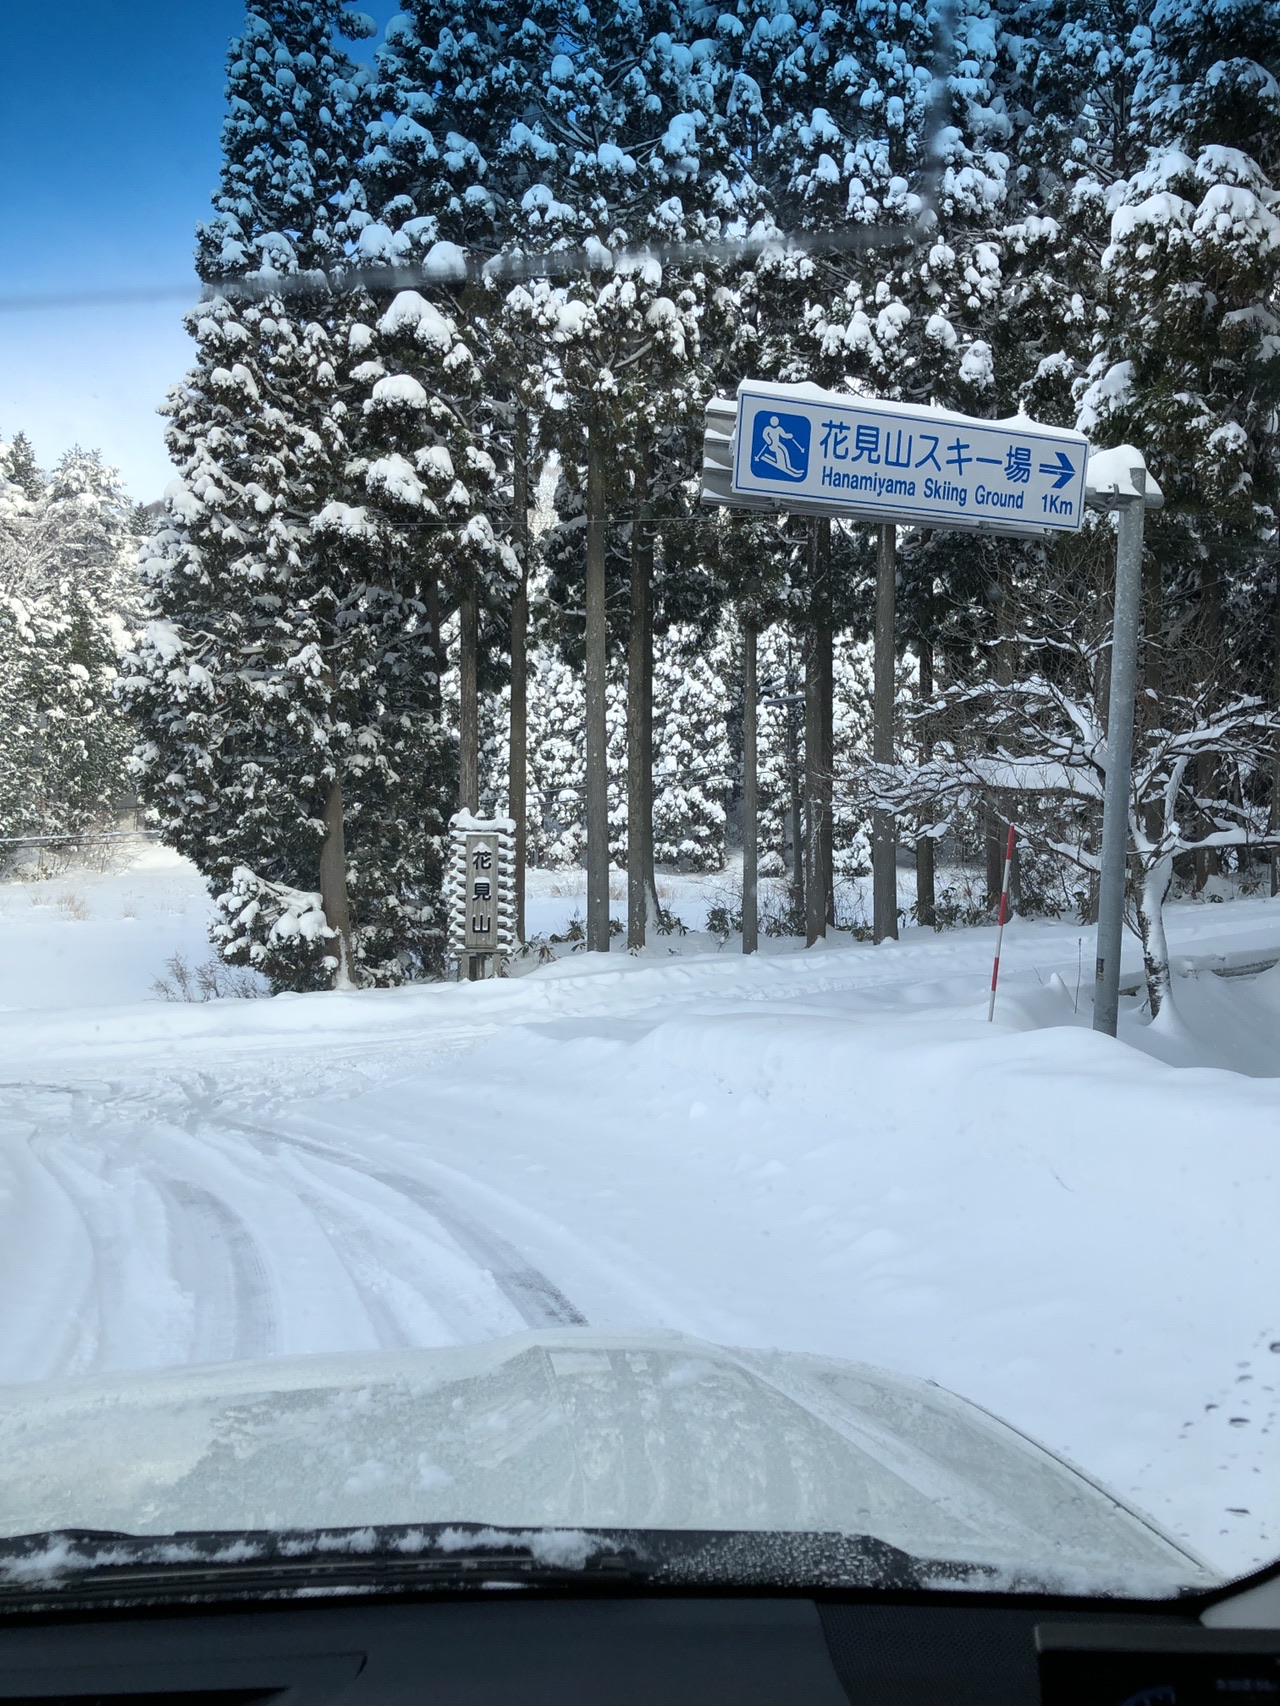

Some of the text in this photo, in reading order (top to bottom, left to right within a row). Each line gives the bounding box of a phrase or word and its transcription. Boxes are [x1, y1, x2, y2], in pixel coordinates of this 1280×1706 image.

[818, 419, 1033, 485] 花見山スキー場
[821, 465, 1074, 515] Hanamiyama Skiing Ground 1Km
[472, 850, 492, 934] 花見山
